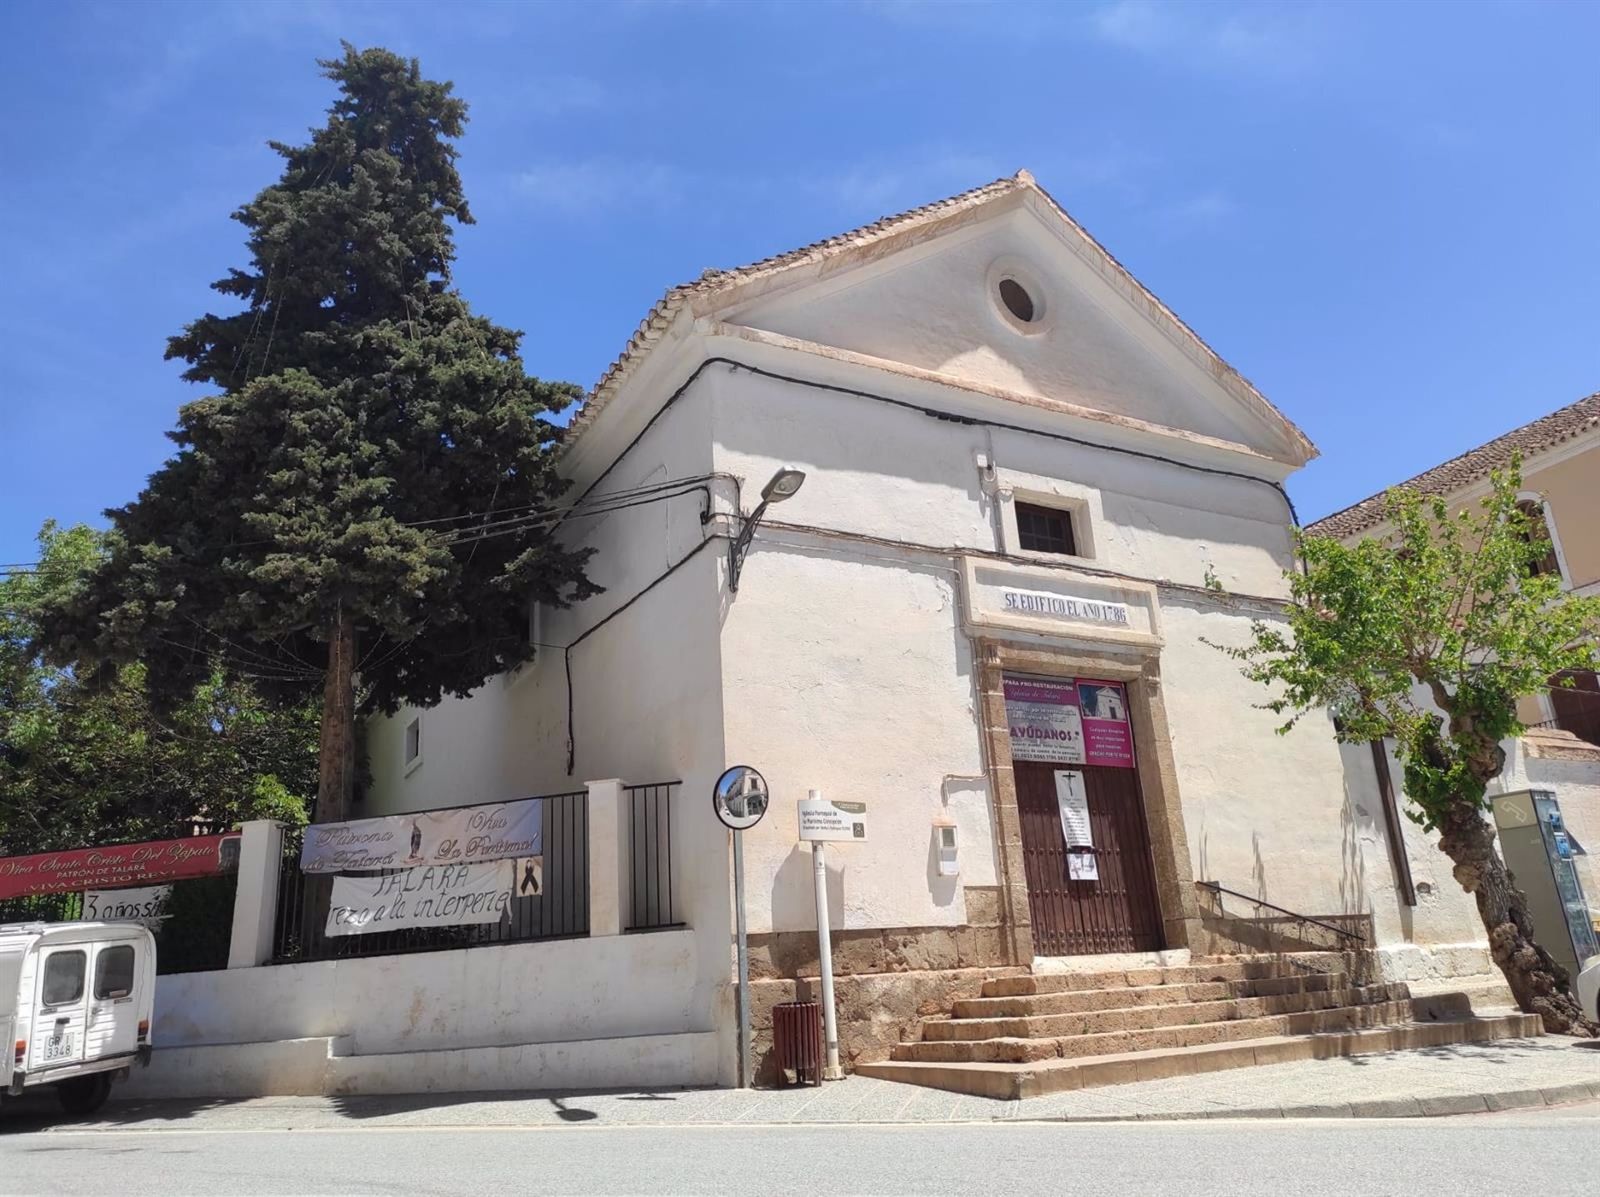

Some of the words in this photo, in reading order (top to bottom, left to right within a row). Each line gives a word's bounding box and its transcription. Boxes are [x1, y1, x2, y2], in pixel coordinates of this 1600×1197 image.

[1005, 593, 1018, 608] SE
[1020, 595, 1065, 615] EDIFICO
[1067, 600, 1079, 616] EL
[1103, 605, 1126, 622] 1786
[1010, 725, 1072, 741] AYÚDANOS
[57, 868, 94, 878] PATRÓN
[97, 867, 107, 875] DE
[112, 863, 145, 874] TALARÁ
[71, 875, 131, 886] CRISTO
[373, 866, 469, 897] TALARA
[88, 895, 99, 920] 3
[374, 905, 386, 921] a
[390, 893, 405, 919] la
